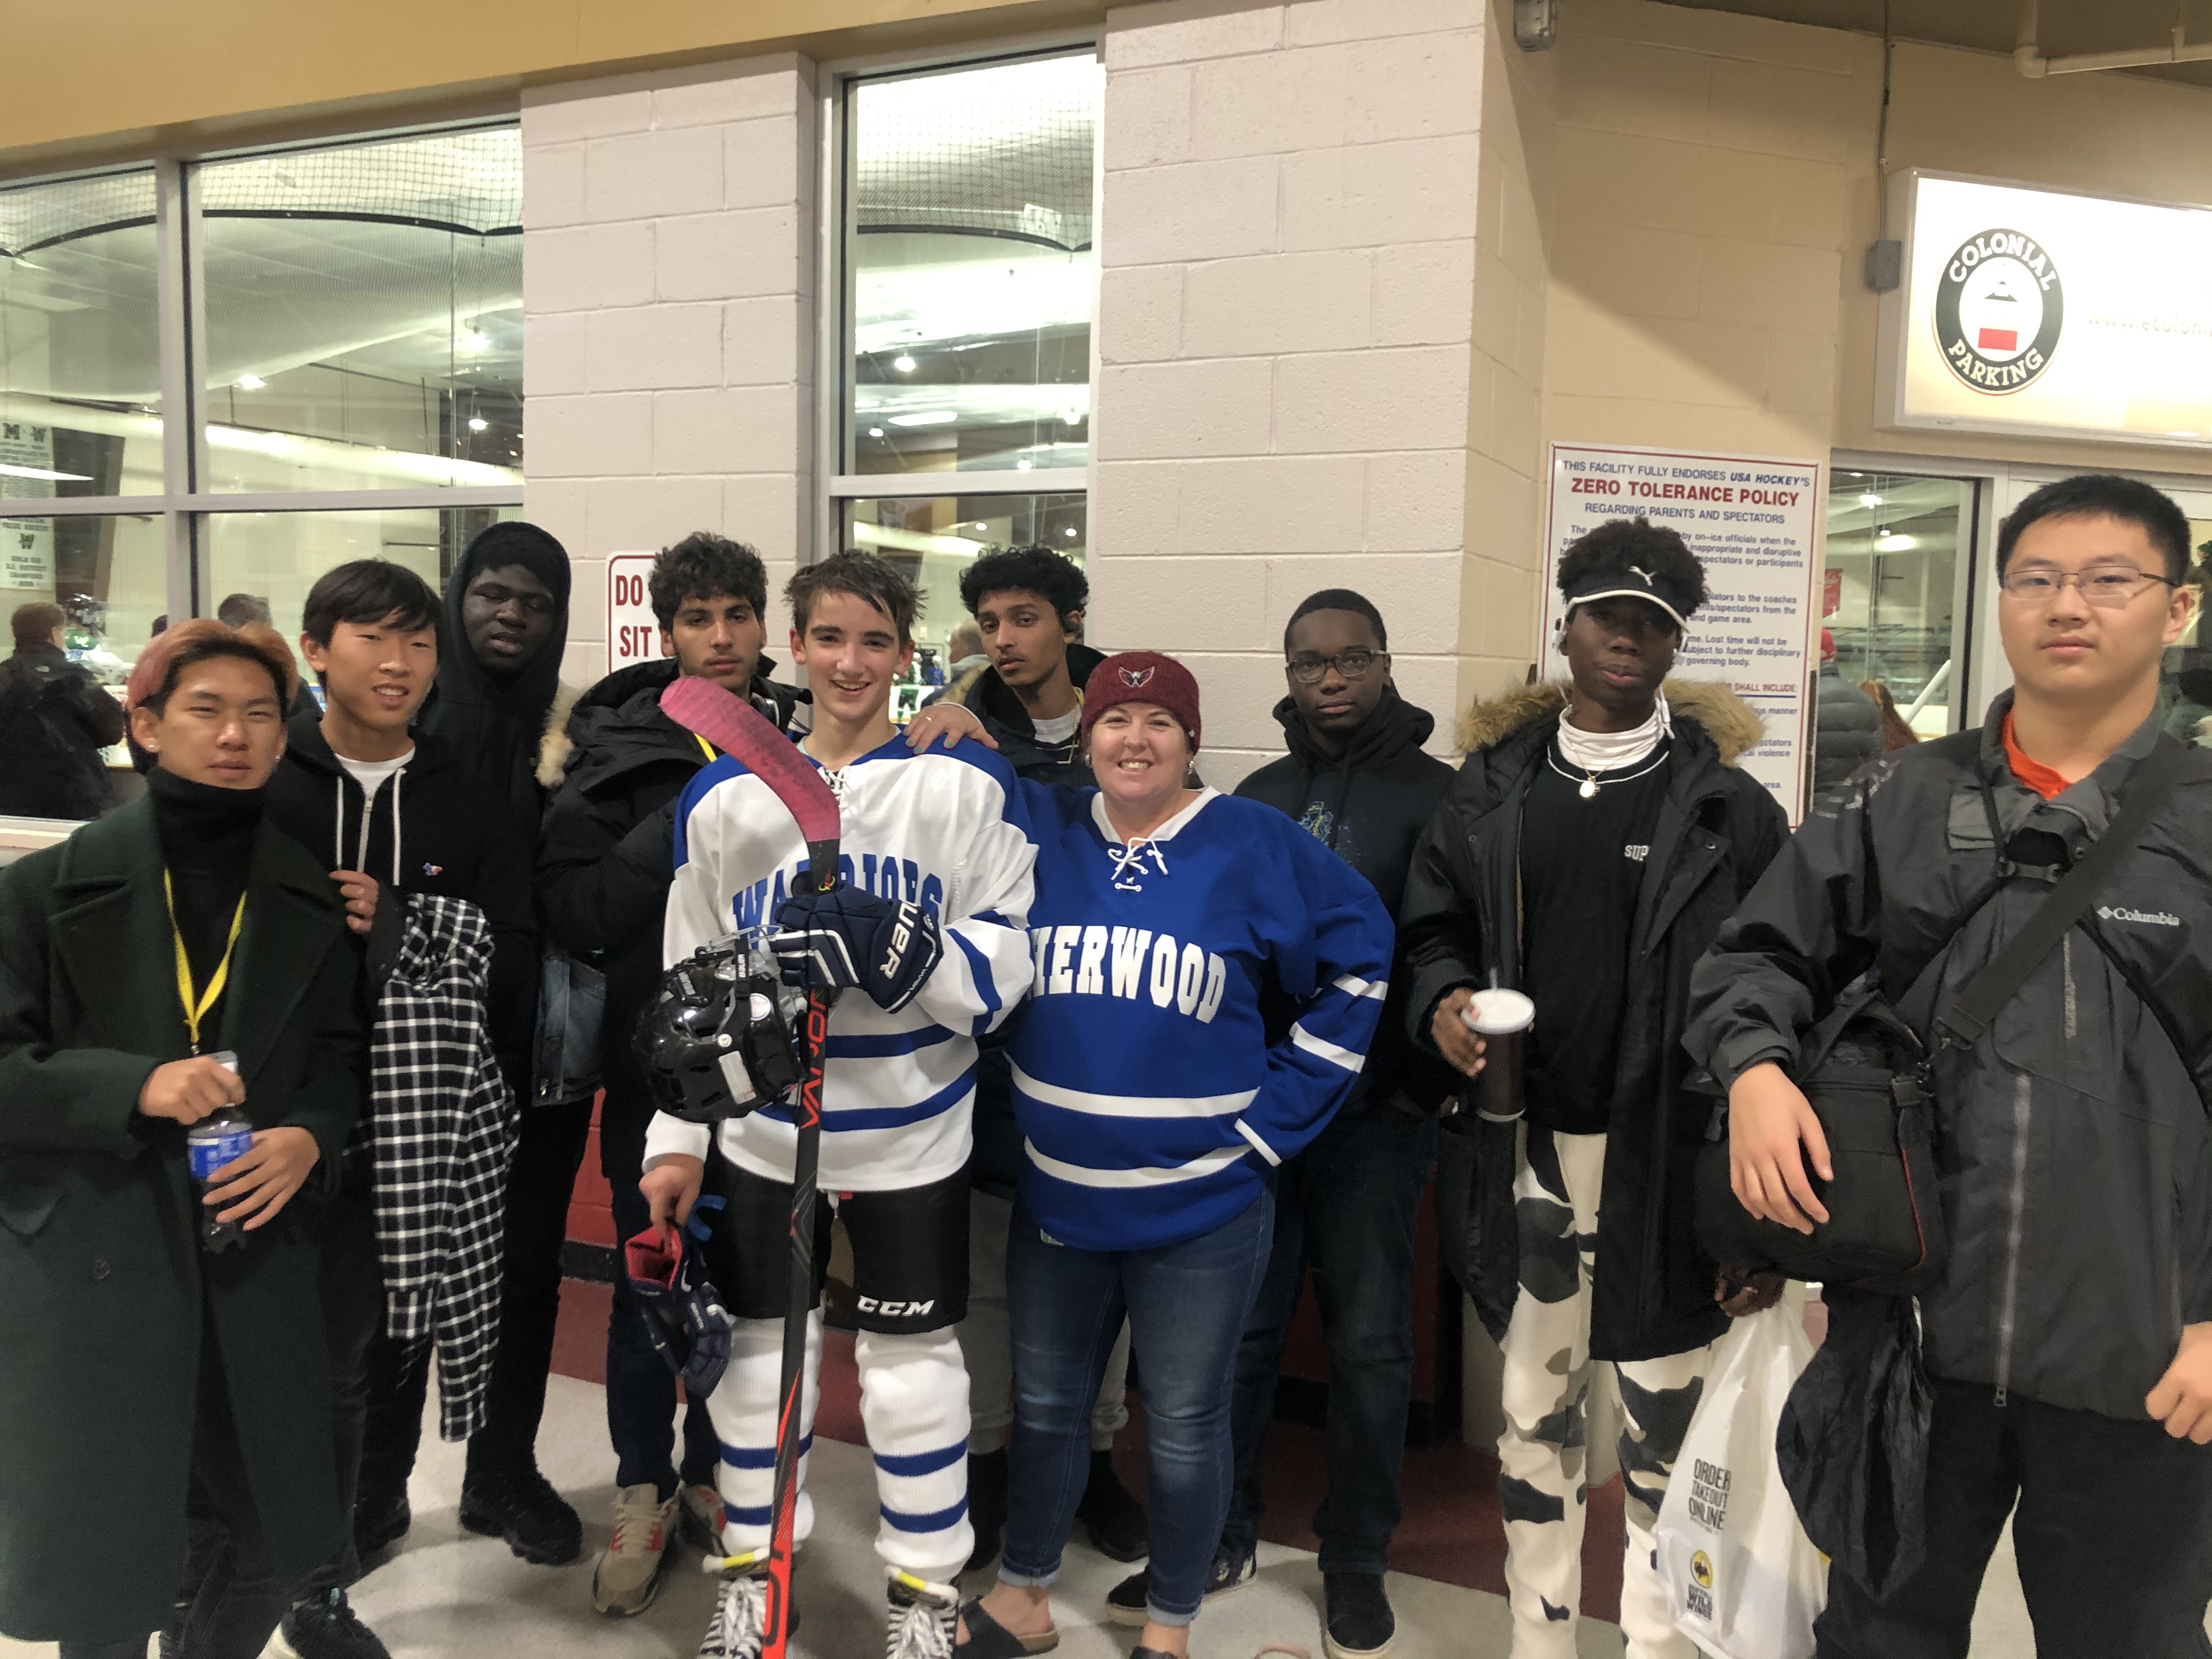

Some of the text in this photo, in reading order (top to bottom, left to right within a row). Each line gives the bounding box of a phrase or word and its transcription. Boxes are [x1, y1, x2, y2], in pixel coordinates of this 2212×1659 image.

[1949, 232, 2057, 291] COLONIAL
[2088, 312, 2212, 338] www.ecoloni
[1948, 339, 2045, 387] PARKING
[1564, 460, 1810, 487] THIS FACILITY FULLY ENDORSES USA HOCKEY'S
[1571, 477, 1799, 507] ZERO TOLERANCE POLICY
[1585, 503, 1785, 524] REGARDING PARENTS AND SPECTATORS
[1571, 524, 1587, 534] The
[1681, 532, 1692, 541] by
[1725, 534, 1757, 544] officials
[1760, 536, 1781, 545] when
[1784, 537, 1796, 546] the
[1690, 542, 1743, 554] inappropriate
[1746, 546, 1760, 555] and
[1763, 547, 1802, 557] disruptive
[1700, 555, 1743, 565] spectators
[1757, 558, 1804, 568] participants
[616, 575, 643, 606] DO
[1738, 593, 1746, 602] to
[1748, 594, 1761, 602] the
[1764, 594, 1797, 603] coaches
[1690, 613, 1706, 622] and
[1707, 615, 1730, 624] game
[1763, 605, 1781, 614] from
[1784, 606, 1797, 614] the
[619, 625, 652, 657] SIT
[1705, 634, 1724, 644] Lost
[1726, 635, 1744, 644] time
[1747, 636, 1760, 645] will
[1762, 636, 1775, 645] not
[1777, 636, 1787, 646] be
[1686, 645, 1801, 659] ubject to further disciplinary
[1686, 657, 1726, 667] governing
[1734, 682, 1760, 692] SHALL
[2113, 907, 2181, 926] Columbia
[879, 901, 919, 980] UER
[856, 1295, 935, 1317] CCM
[1694, 1458, 1732, 1492] ORDER
[1691, 1480, 1729, 1509] TAKEOUT
[1688, 1497, 1726, 1531] ONLINE
